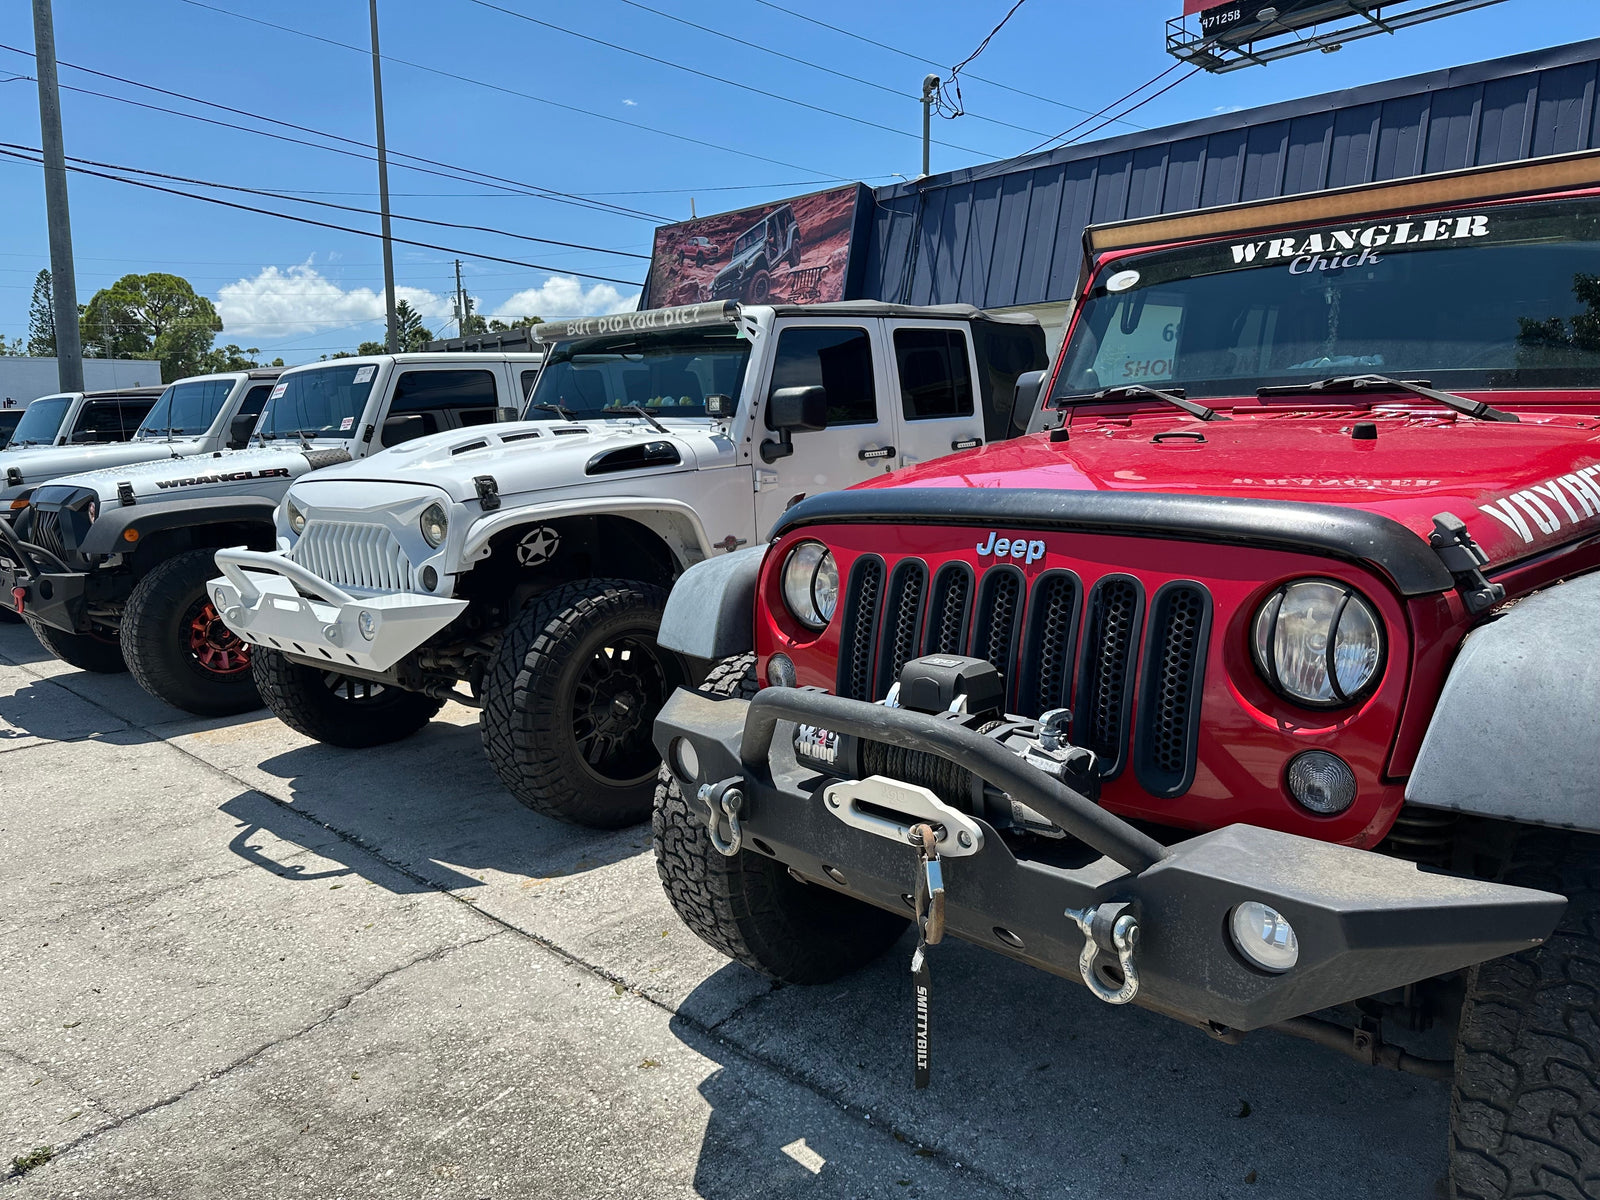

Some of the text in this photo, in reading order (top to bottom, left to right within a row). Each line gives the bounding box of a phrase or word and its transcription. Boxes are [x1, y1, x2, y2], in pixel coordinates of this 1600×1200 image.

[1202, 10, 1240, 28] 47125B
[1230, 215, 1490, 264] WRANGLER
[1288, 248, 1385, 275] Chick
[566, 306, 700, 336] BUT DID YOU DIE?
[1122, 358, 1173, 378] SHO
[155, 468, 292, 489] WRANGLER
[1478, 464, 1600, 544] VOYA
[976, 531, 1046, 565] Jeep
[916, 985, 928, 1070] SMITTYBILT
